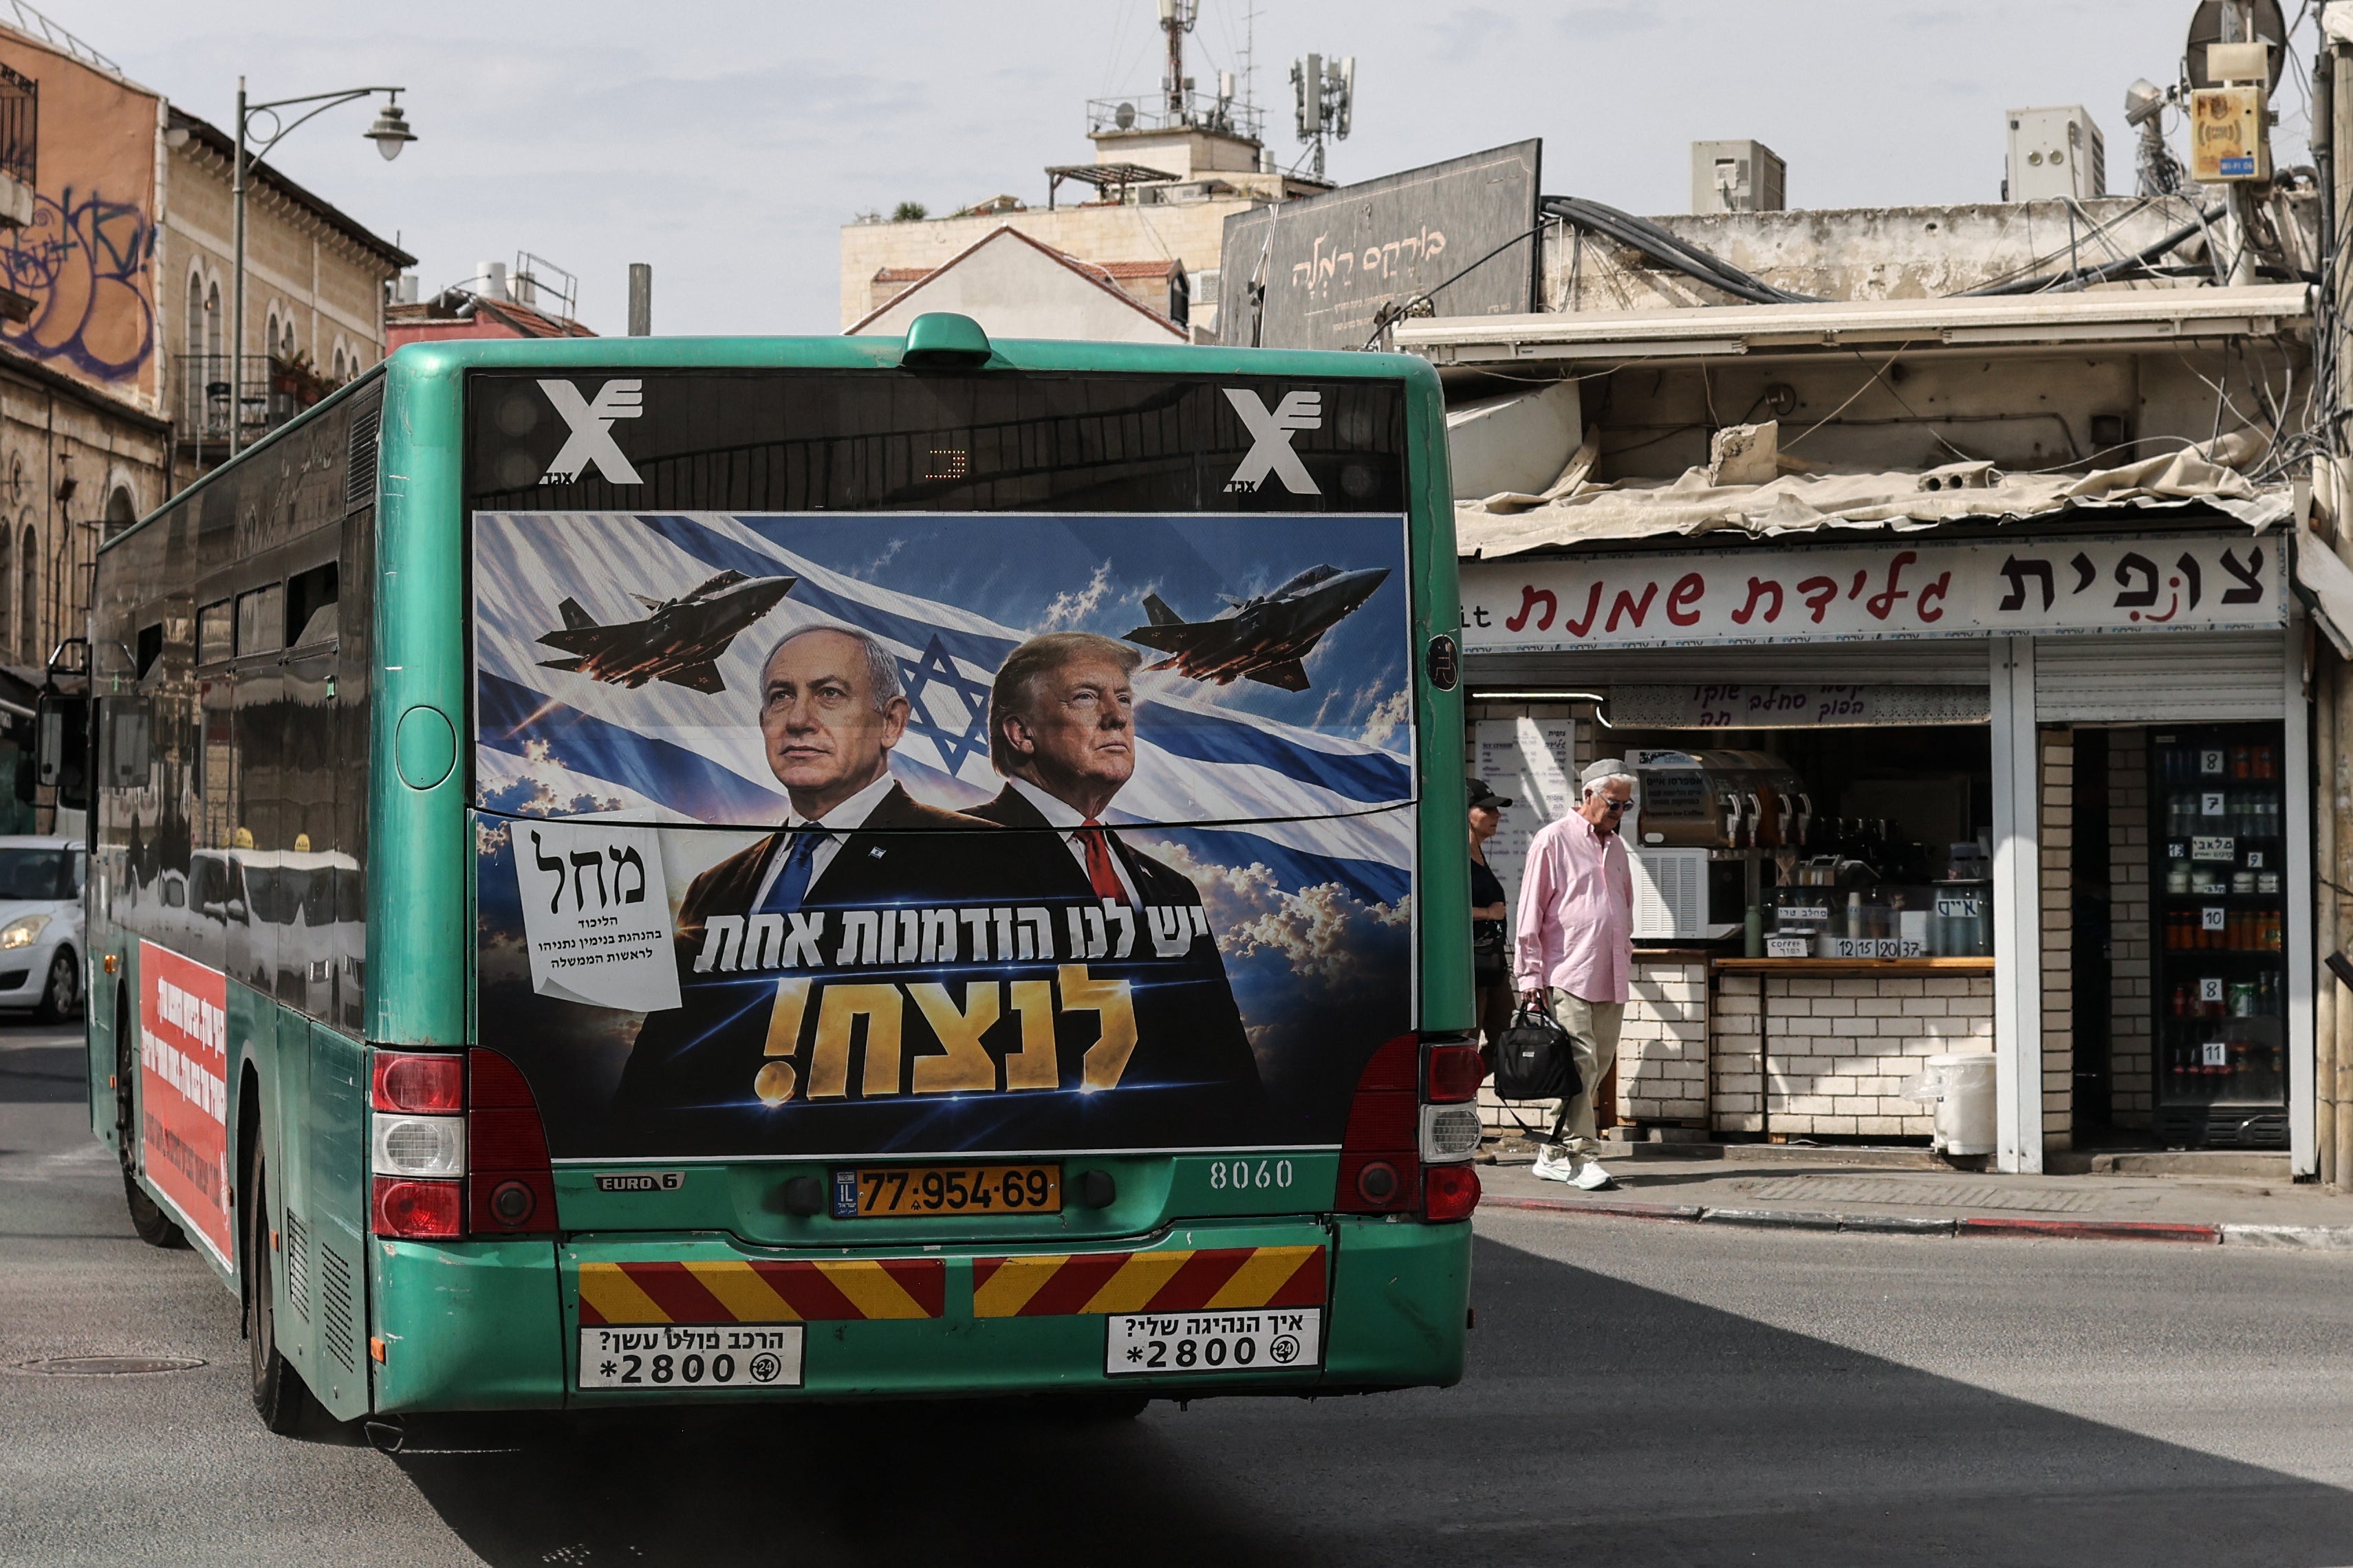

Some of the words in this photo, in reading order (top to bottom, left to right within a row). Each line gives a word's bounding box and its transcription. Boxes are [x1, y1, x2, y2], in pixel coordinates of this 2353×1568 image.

[543, 472, 573, 484] אגד
[1731, 551, 1951, 624] גלידת
[1506, 572, 1704, 638] שמנת
[1750, 686, 1806, 710] סחלב
[2207, 753, 2218, 770] 8
[530, 829, 646, 915] מחל
[1937, 900, 1978, 916] אייס
[578, 915, 618, 928] הליכוד
[2205, 912, 2222, 925] 10
[835, 906, 1053, 966] הזדמנות
[1067, 897, 1135, 959] לנו
[1151, 904, 1209, 958] יש
[538, 939, 576, 952] נתניהו
[579, 937, 615, 950] בנימין
[618, 930, 662, 944] בהנהגת
[692, 911, 827, 974] אחת
[607, 947, 653, 963] לראשות
[1839, 940, 1854, 957] 12
[1858, 941, 1872, 955] 15
[1880, 941, 1898, 957] 20
[1902, 941, 1919, 957] 37
[551, 953, 603, 969] הממשלה
[2206, 981, 2218, 997] 8
[754, 963, 1139, 1104] לנצח!
[2205, 1045, 2221, 1060] 11
[602, 1177, 653, 1190] EURO
[662, 1174, 678, 1188] 6
[1210, 1159, 1293, 1188] 8060
[841, 1184, 853, 1202] IL
[1125, 1316, 1179, 1338] שלי?
[1186, 1316, 1260, 1335] הנהיגה
[1267, 1314, 1303, 1335] איך
[599, 1331, 659, 1354] עשן?
[666, 1329, 720, 1350] פולט
[728, 1331, 783, 1349] הרכב
